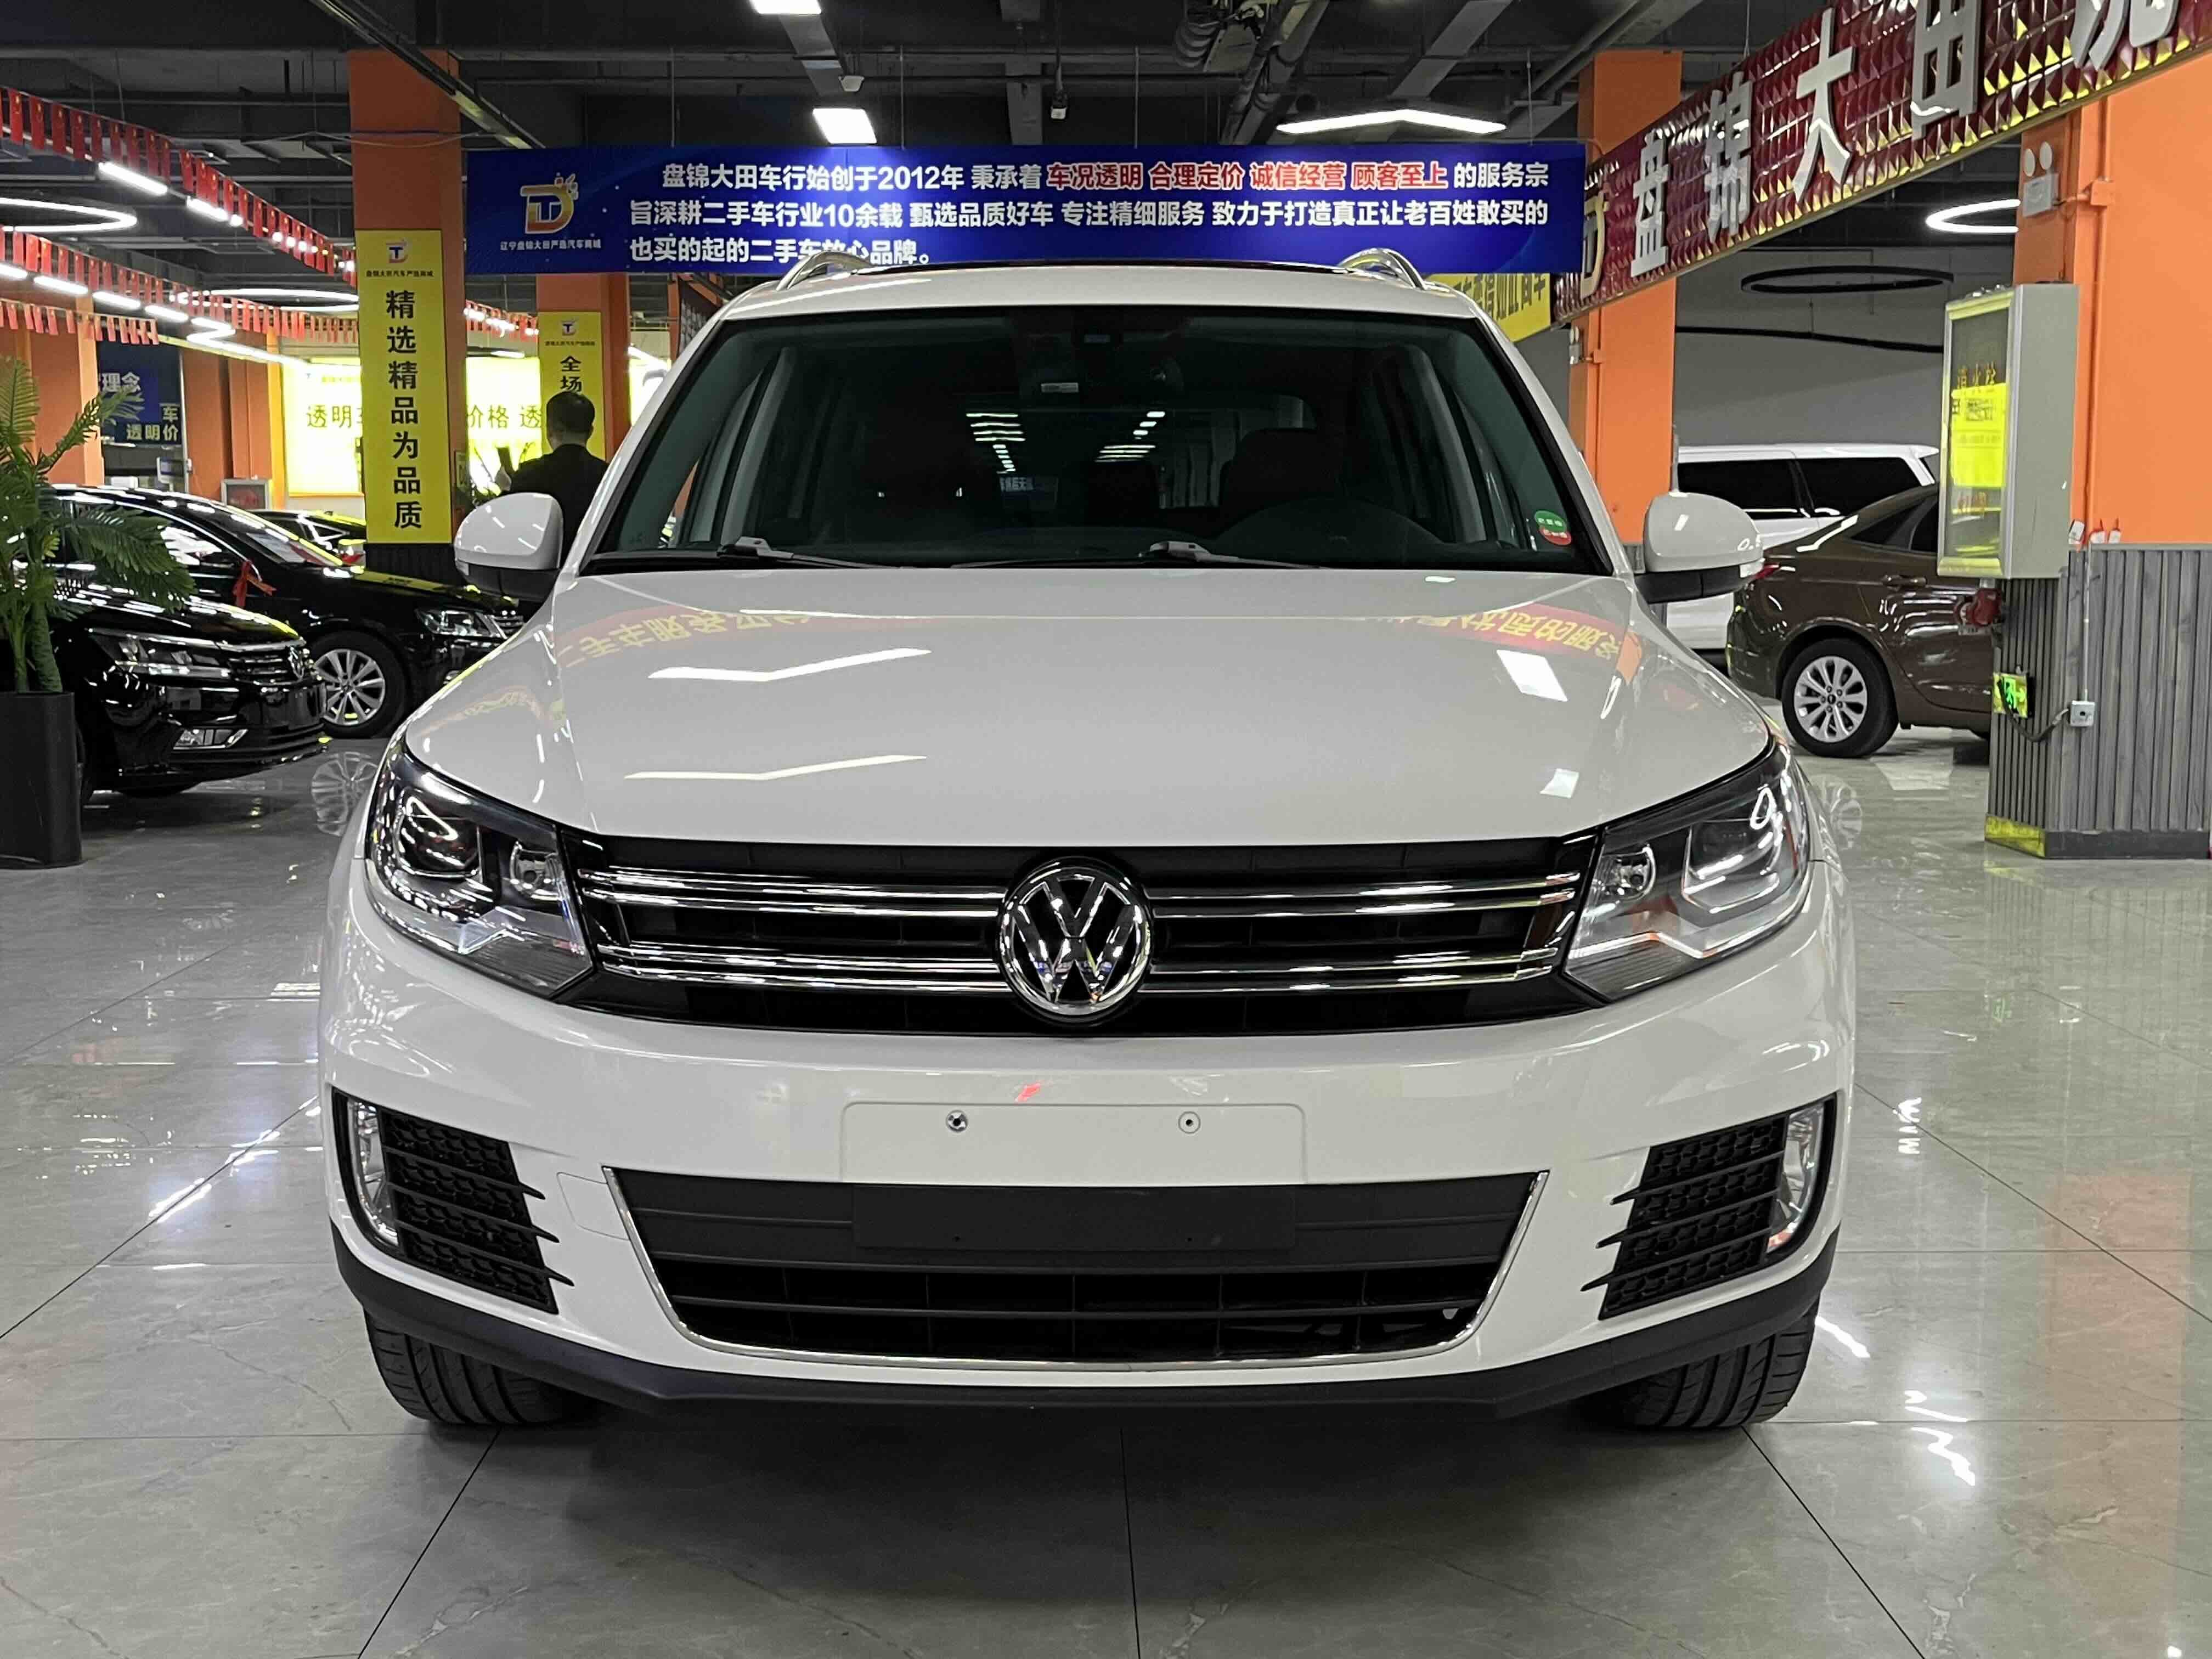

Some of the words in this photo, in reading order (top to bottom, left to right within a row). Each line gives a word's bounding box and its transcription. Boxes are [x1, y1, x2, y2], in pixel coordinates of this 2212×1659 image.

[662, 165, 964, 191] 盘锦大田车行始创于2012年
[971, 165, 1041, 190] 秉承着
[1046, 162, 1144, 191] 车况透明
[1149, 162, 1244, 190] 合理定价
[1249, 161, 1346, 190] 诚信经营
[1350, 160, 1449, 190] 顾客至上
[1453, 163, 1548, 188] 的服务宗
[630, 200, 904, 228] 旨深耕二手车行业10余载
[909, 200, 1053, 228] 甄选品质好车
[1061, 200, 1205, 227] 专注精细服务
[1212, 200, 1548, 227] 致力于打造真正让老百姓敢买的
[98, 372, 141, 393] 理念
[560, 356, 583, 392] 全场
[386, 290, 422, 529] 精选精品为品质
[467, 404, 509, 428] 价格
